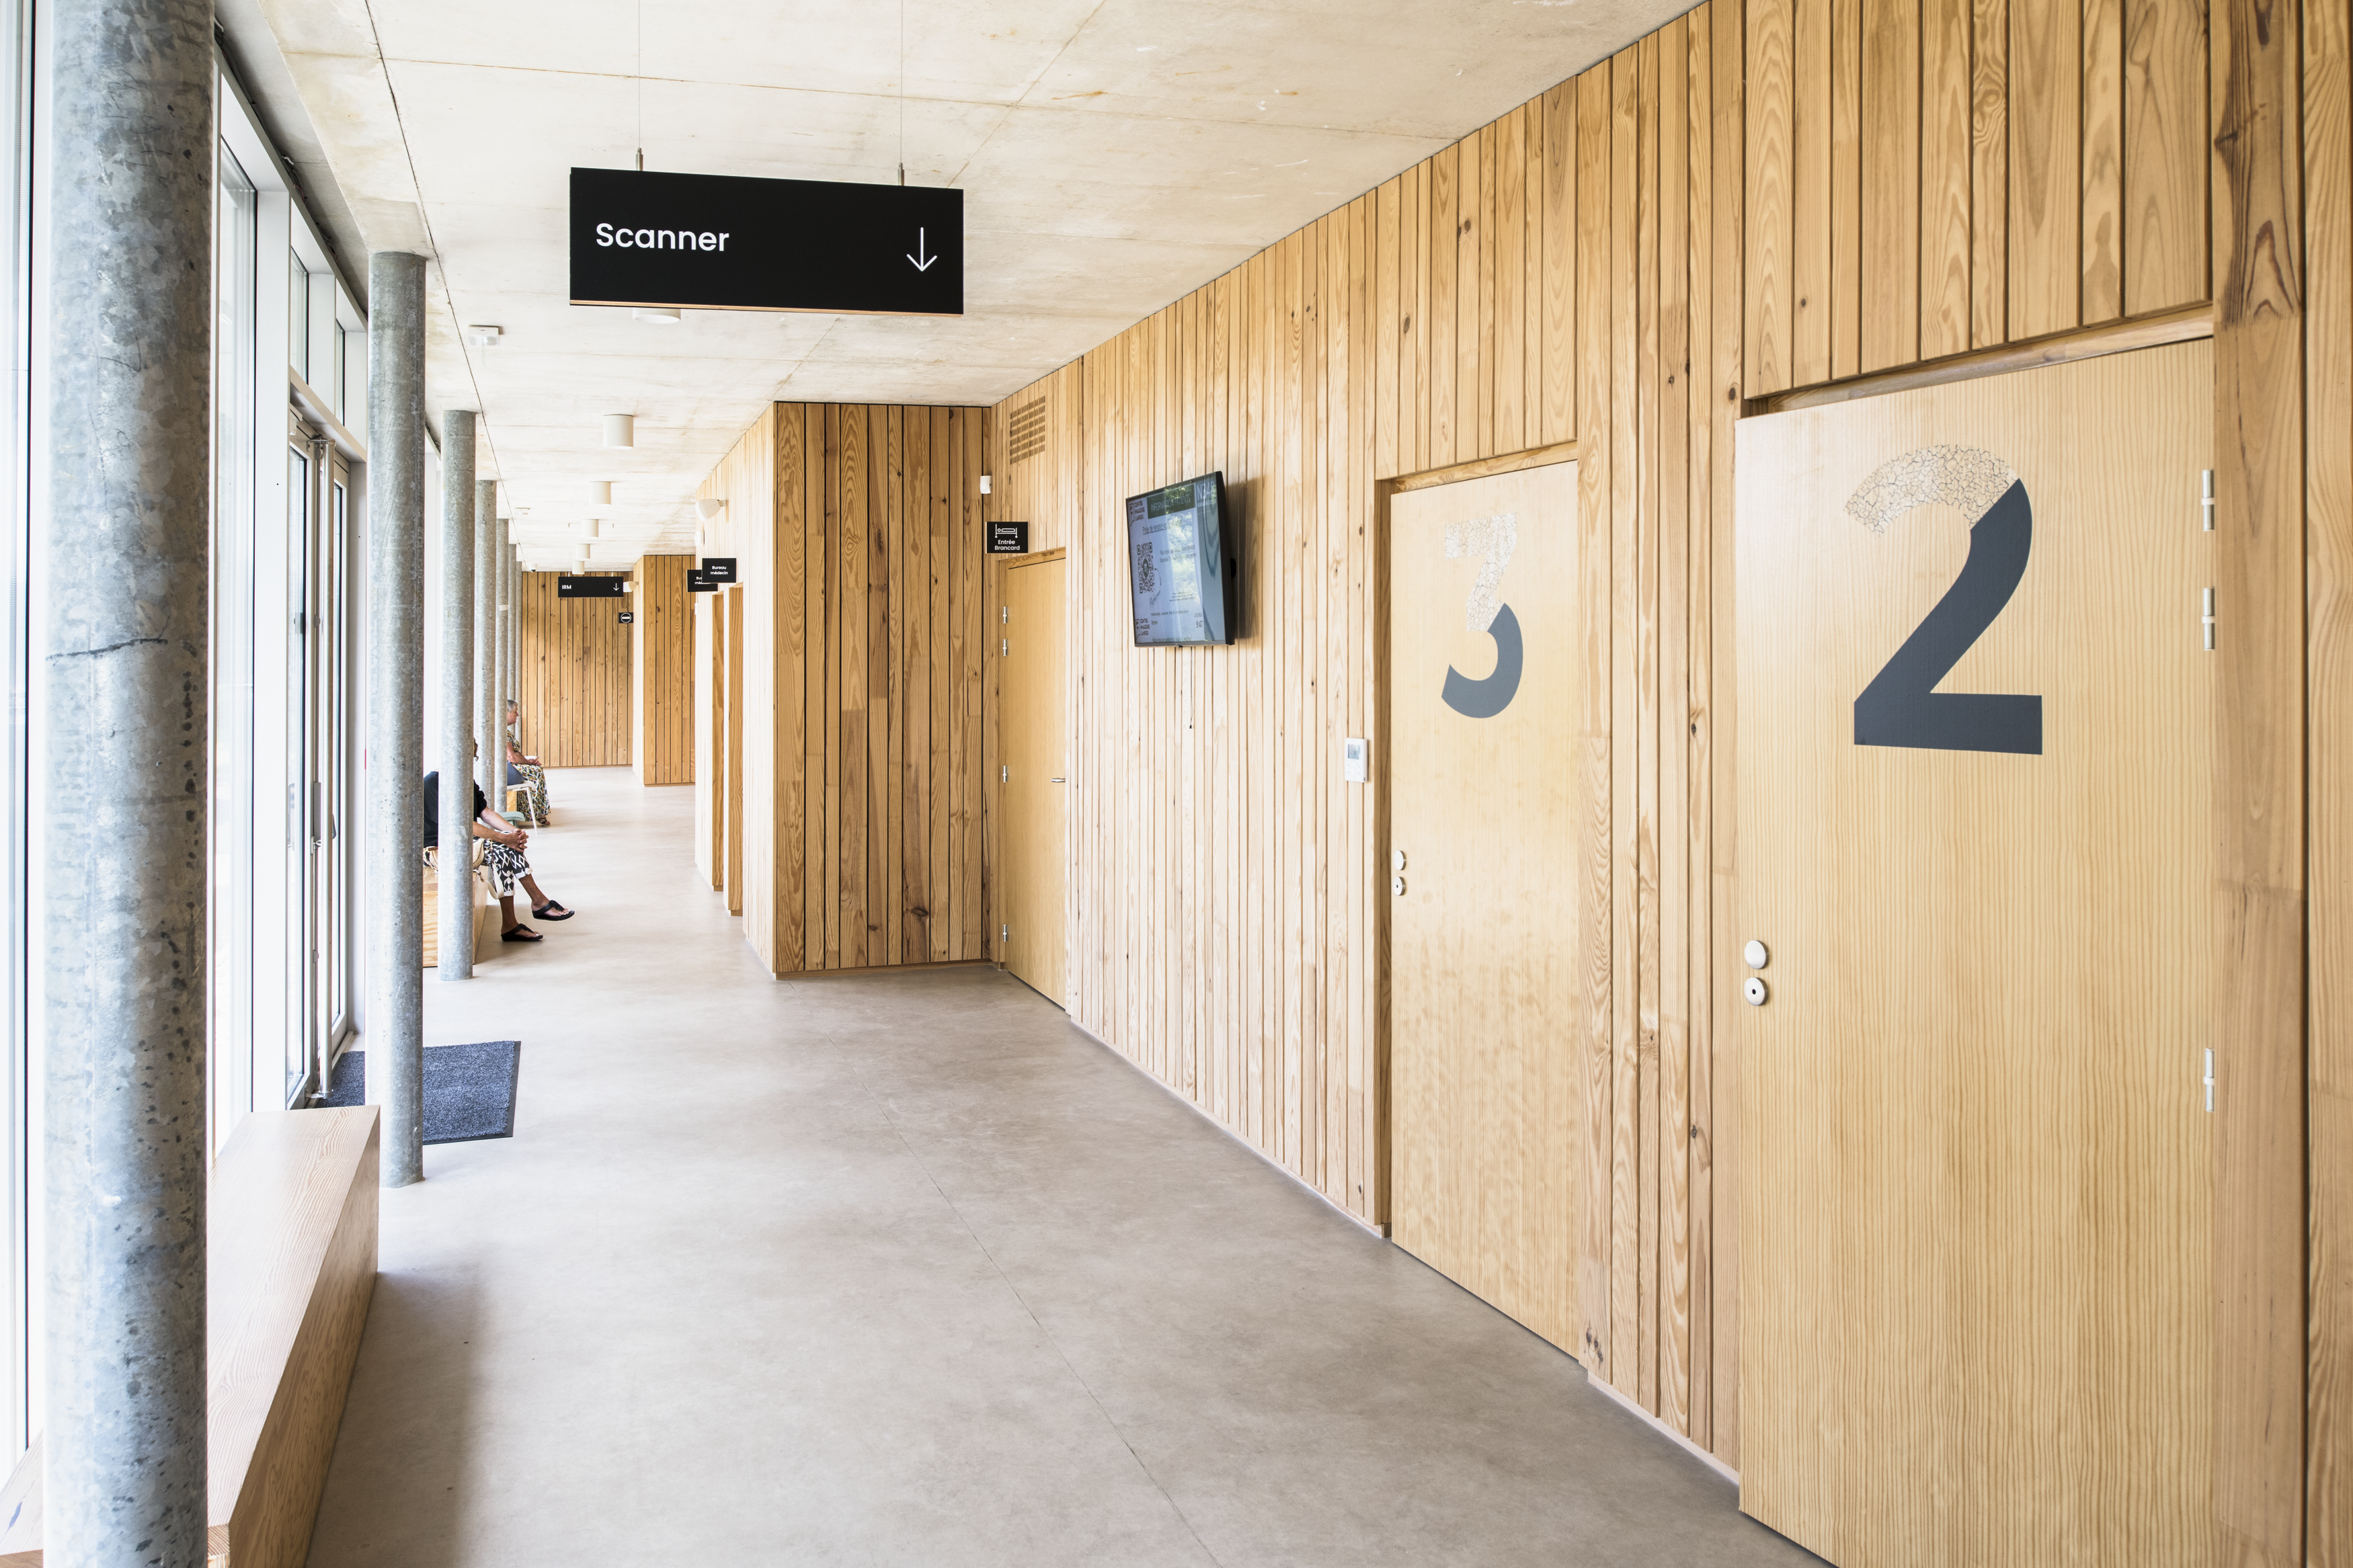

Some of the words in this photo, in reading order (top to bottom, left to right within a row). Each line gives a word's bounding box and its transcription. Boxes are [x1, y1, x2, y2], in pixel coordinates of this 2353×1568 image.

[596, 222, 729, 251] Scanner
[1134, 506, 1145, 515] IMAGERIE
[1135, 513, 1144, 522] LANDES
[1843, 444, 2043, 755] 2
[1441, 511, 1523, 718] 3
